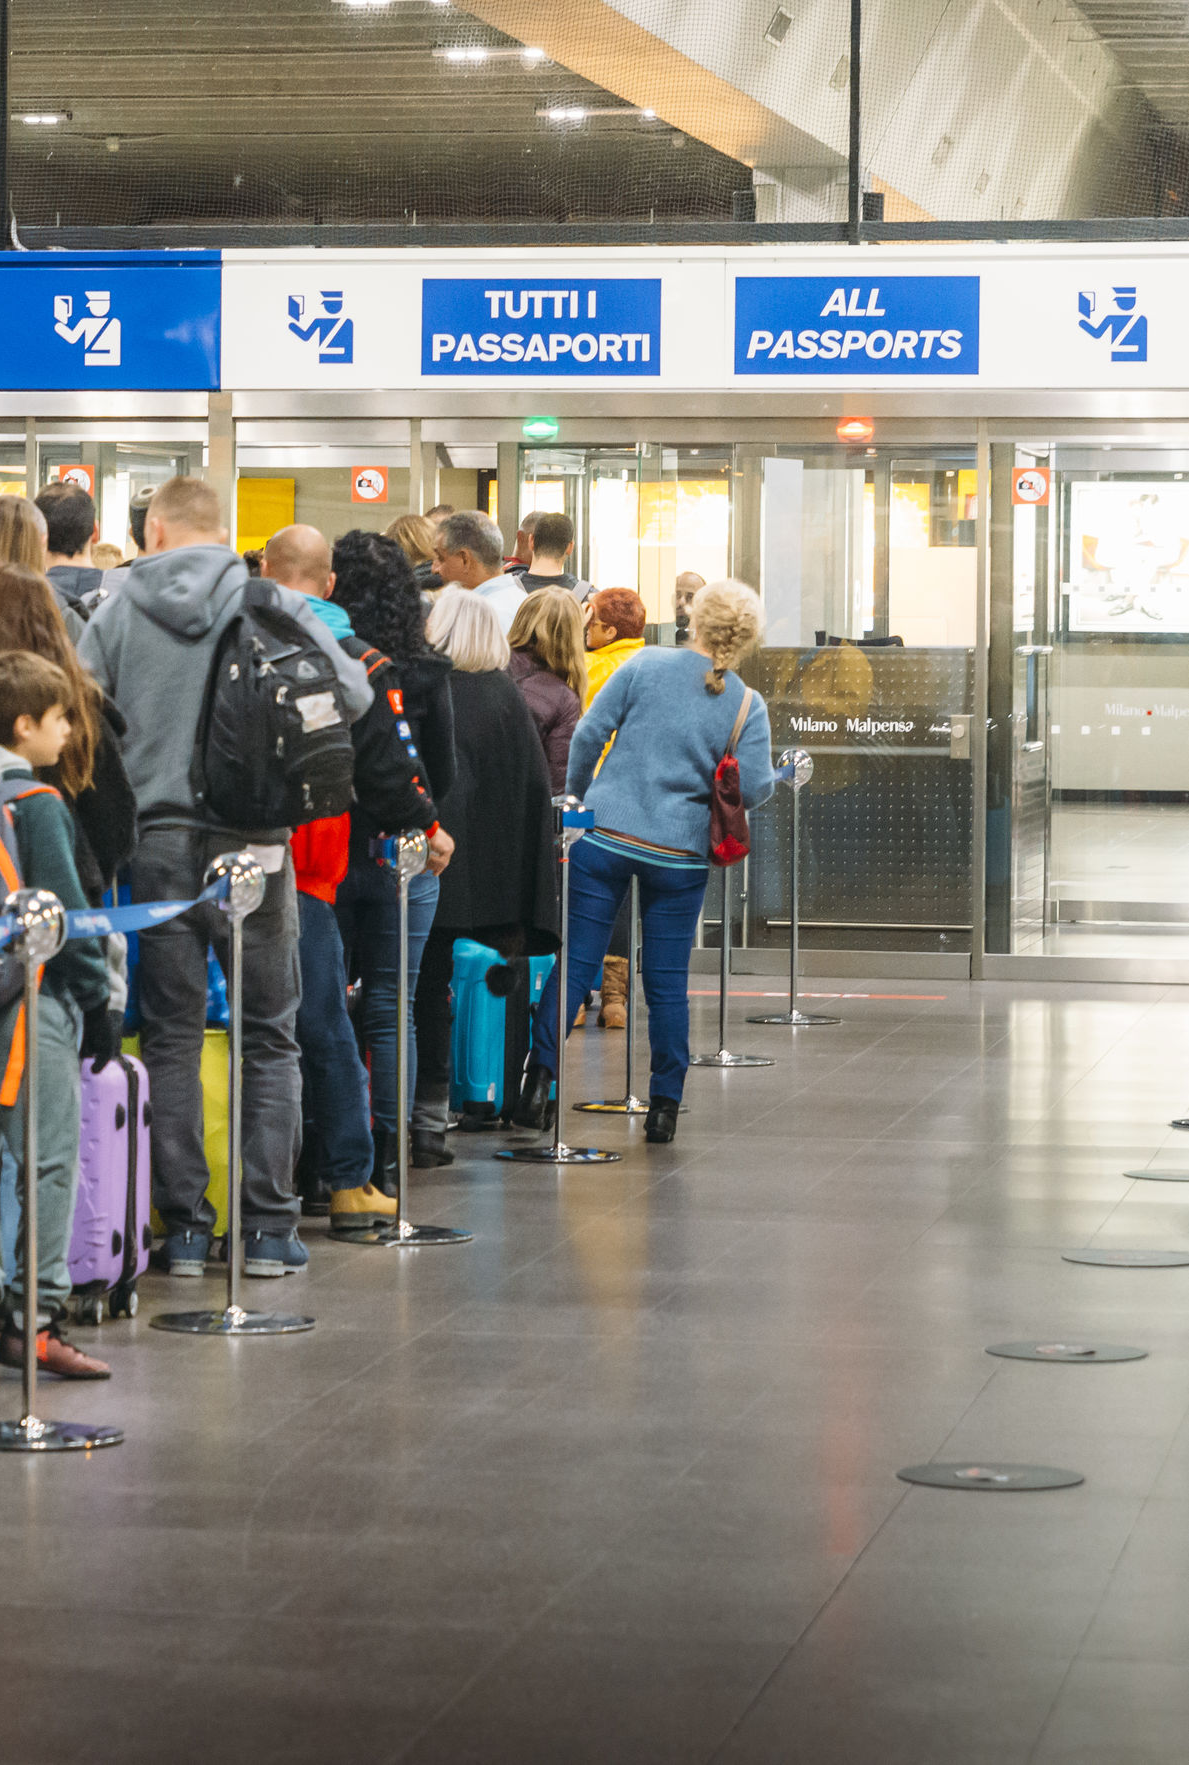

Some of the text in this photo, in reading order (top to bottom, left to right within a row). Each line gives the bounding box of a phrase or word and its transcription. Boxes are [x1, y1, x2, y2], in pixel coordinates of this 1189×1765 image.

[484, 290, 596, 319] TUTTI I
[819, 288, 886, 317] ALL
[432, 333, 650, 362] PASSAPORTI
[746, 329, 963, 359] PASSPORTS
[790, 717, 838, 732] Milano
[846, 717, 913, 736] Malpensa
